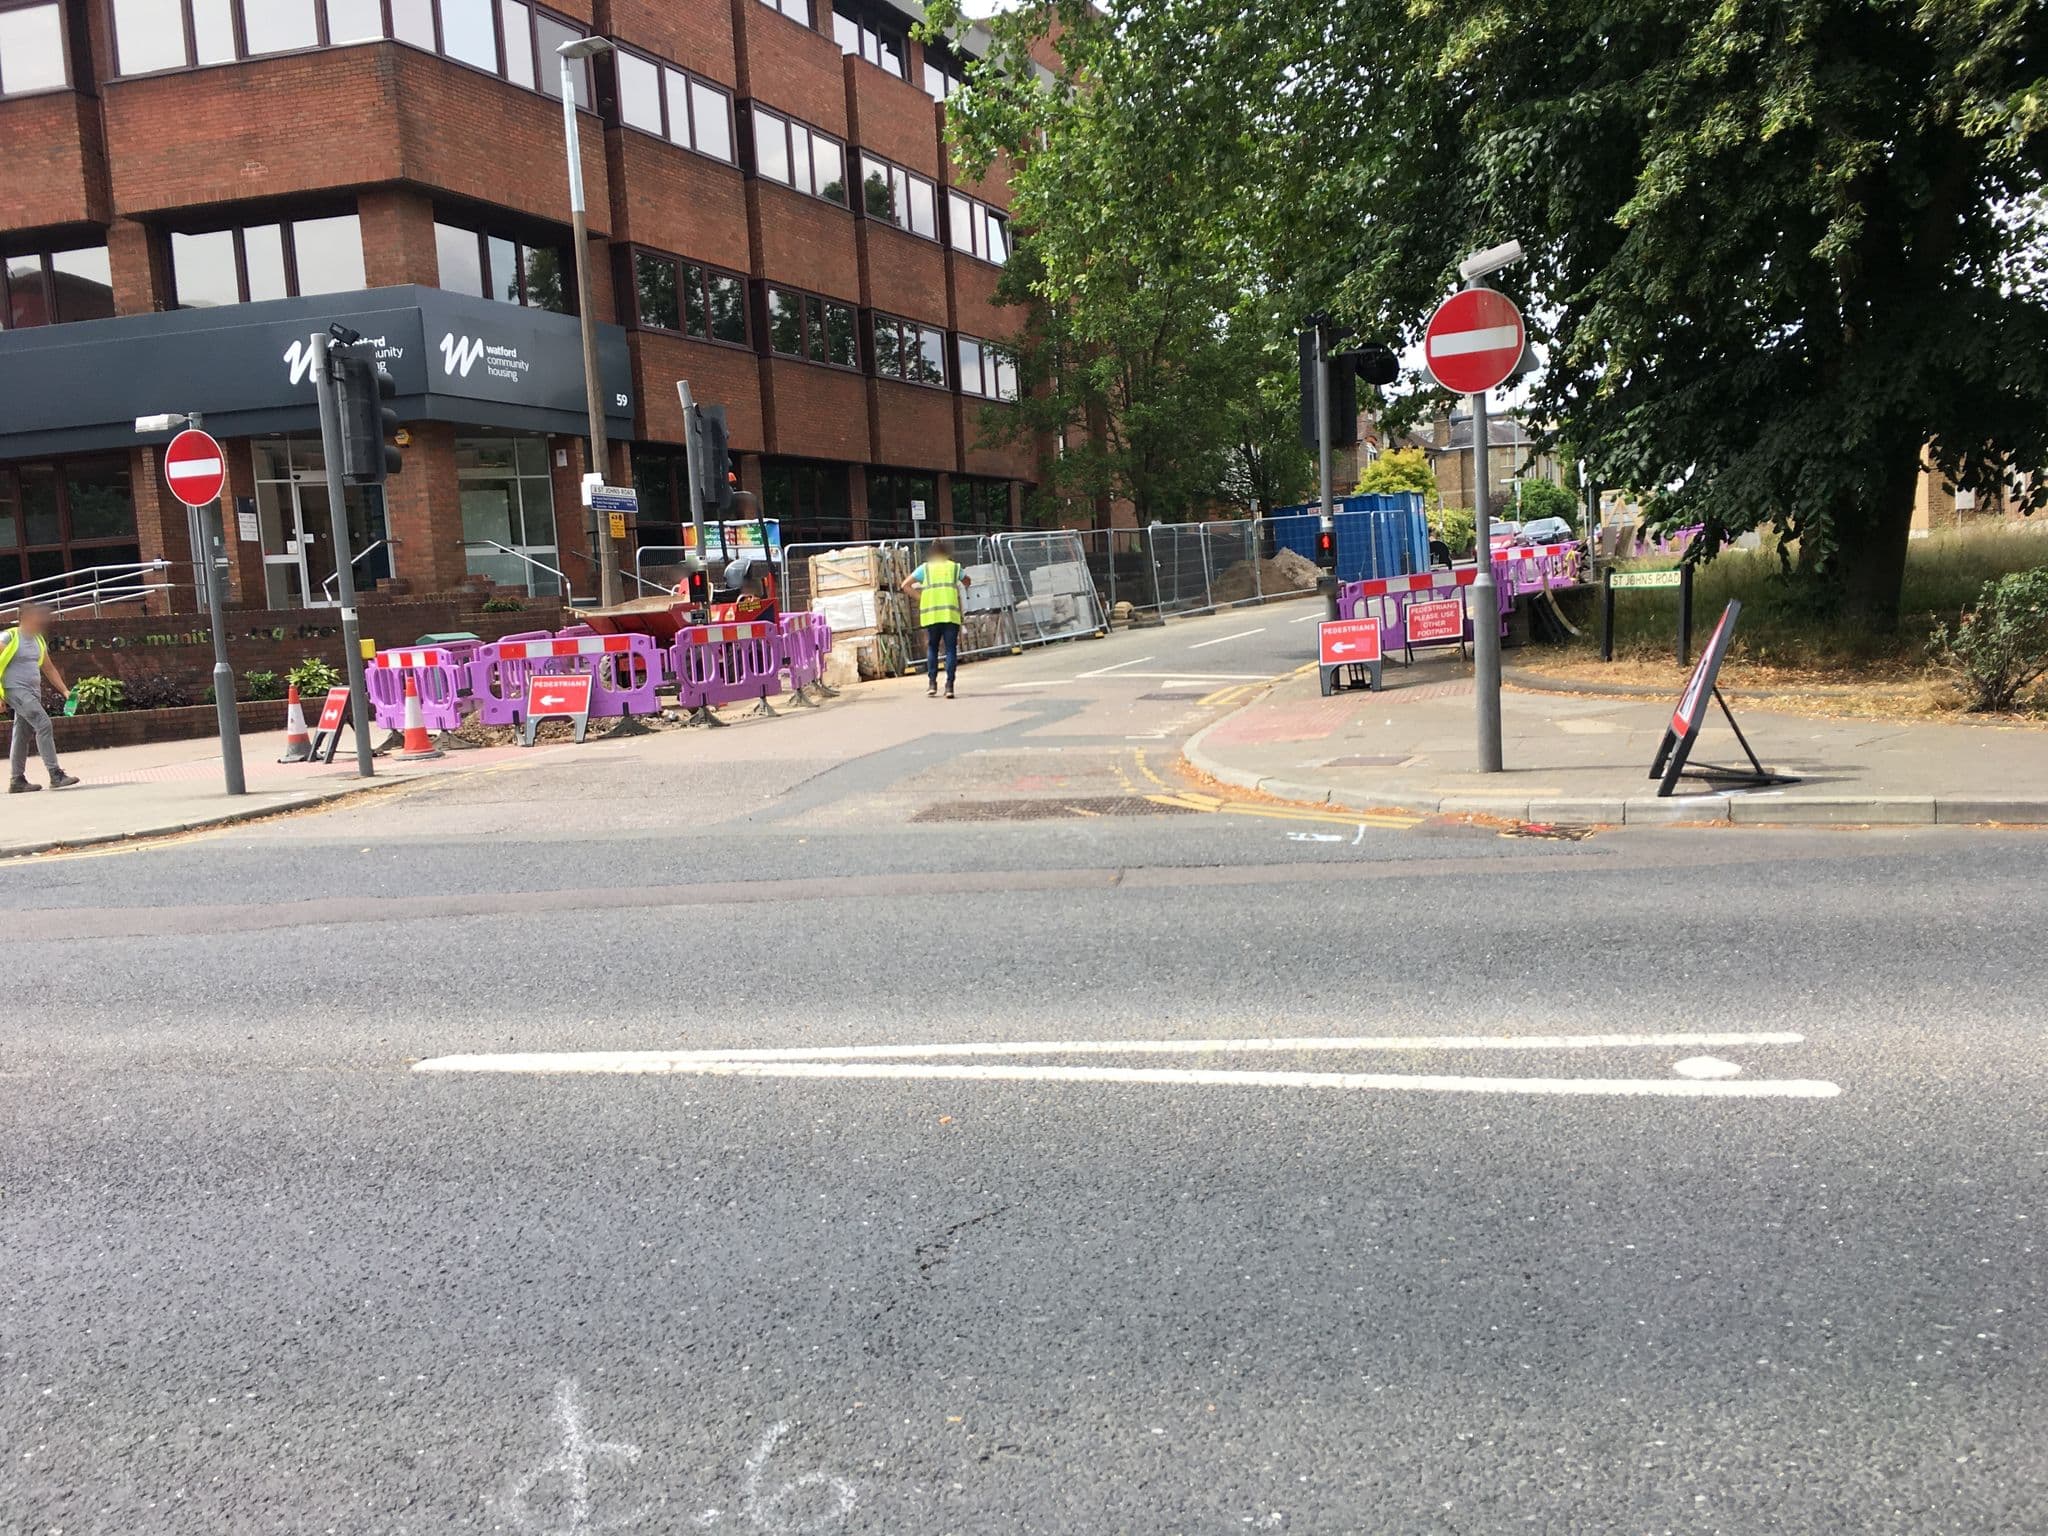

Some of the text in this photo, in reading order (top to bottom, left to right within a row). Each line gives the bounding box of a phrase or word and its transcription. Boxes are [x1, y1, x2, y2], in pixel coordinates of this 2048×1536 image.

[375, 346, 404, 359] unity
[486, 345, 517, 358] watford
[486, 356, 529, 372] community
[487, 364, 519, 383] housing
[616, 393, 628, 407] 59
[1612, 572, 1680, 586] ST JOHNS ROAD
[1410, 602, 1458, 615] PEDESTRIANS
[1413, 610, 1456, 622] PLEASE USE
[1323, 623, 1376, 636] PEDESTRIANS
[1422, 619, 1446, 629] OTHER
[1417, 626, 1453, 638] FOOTPATH
